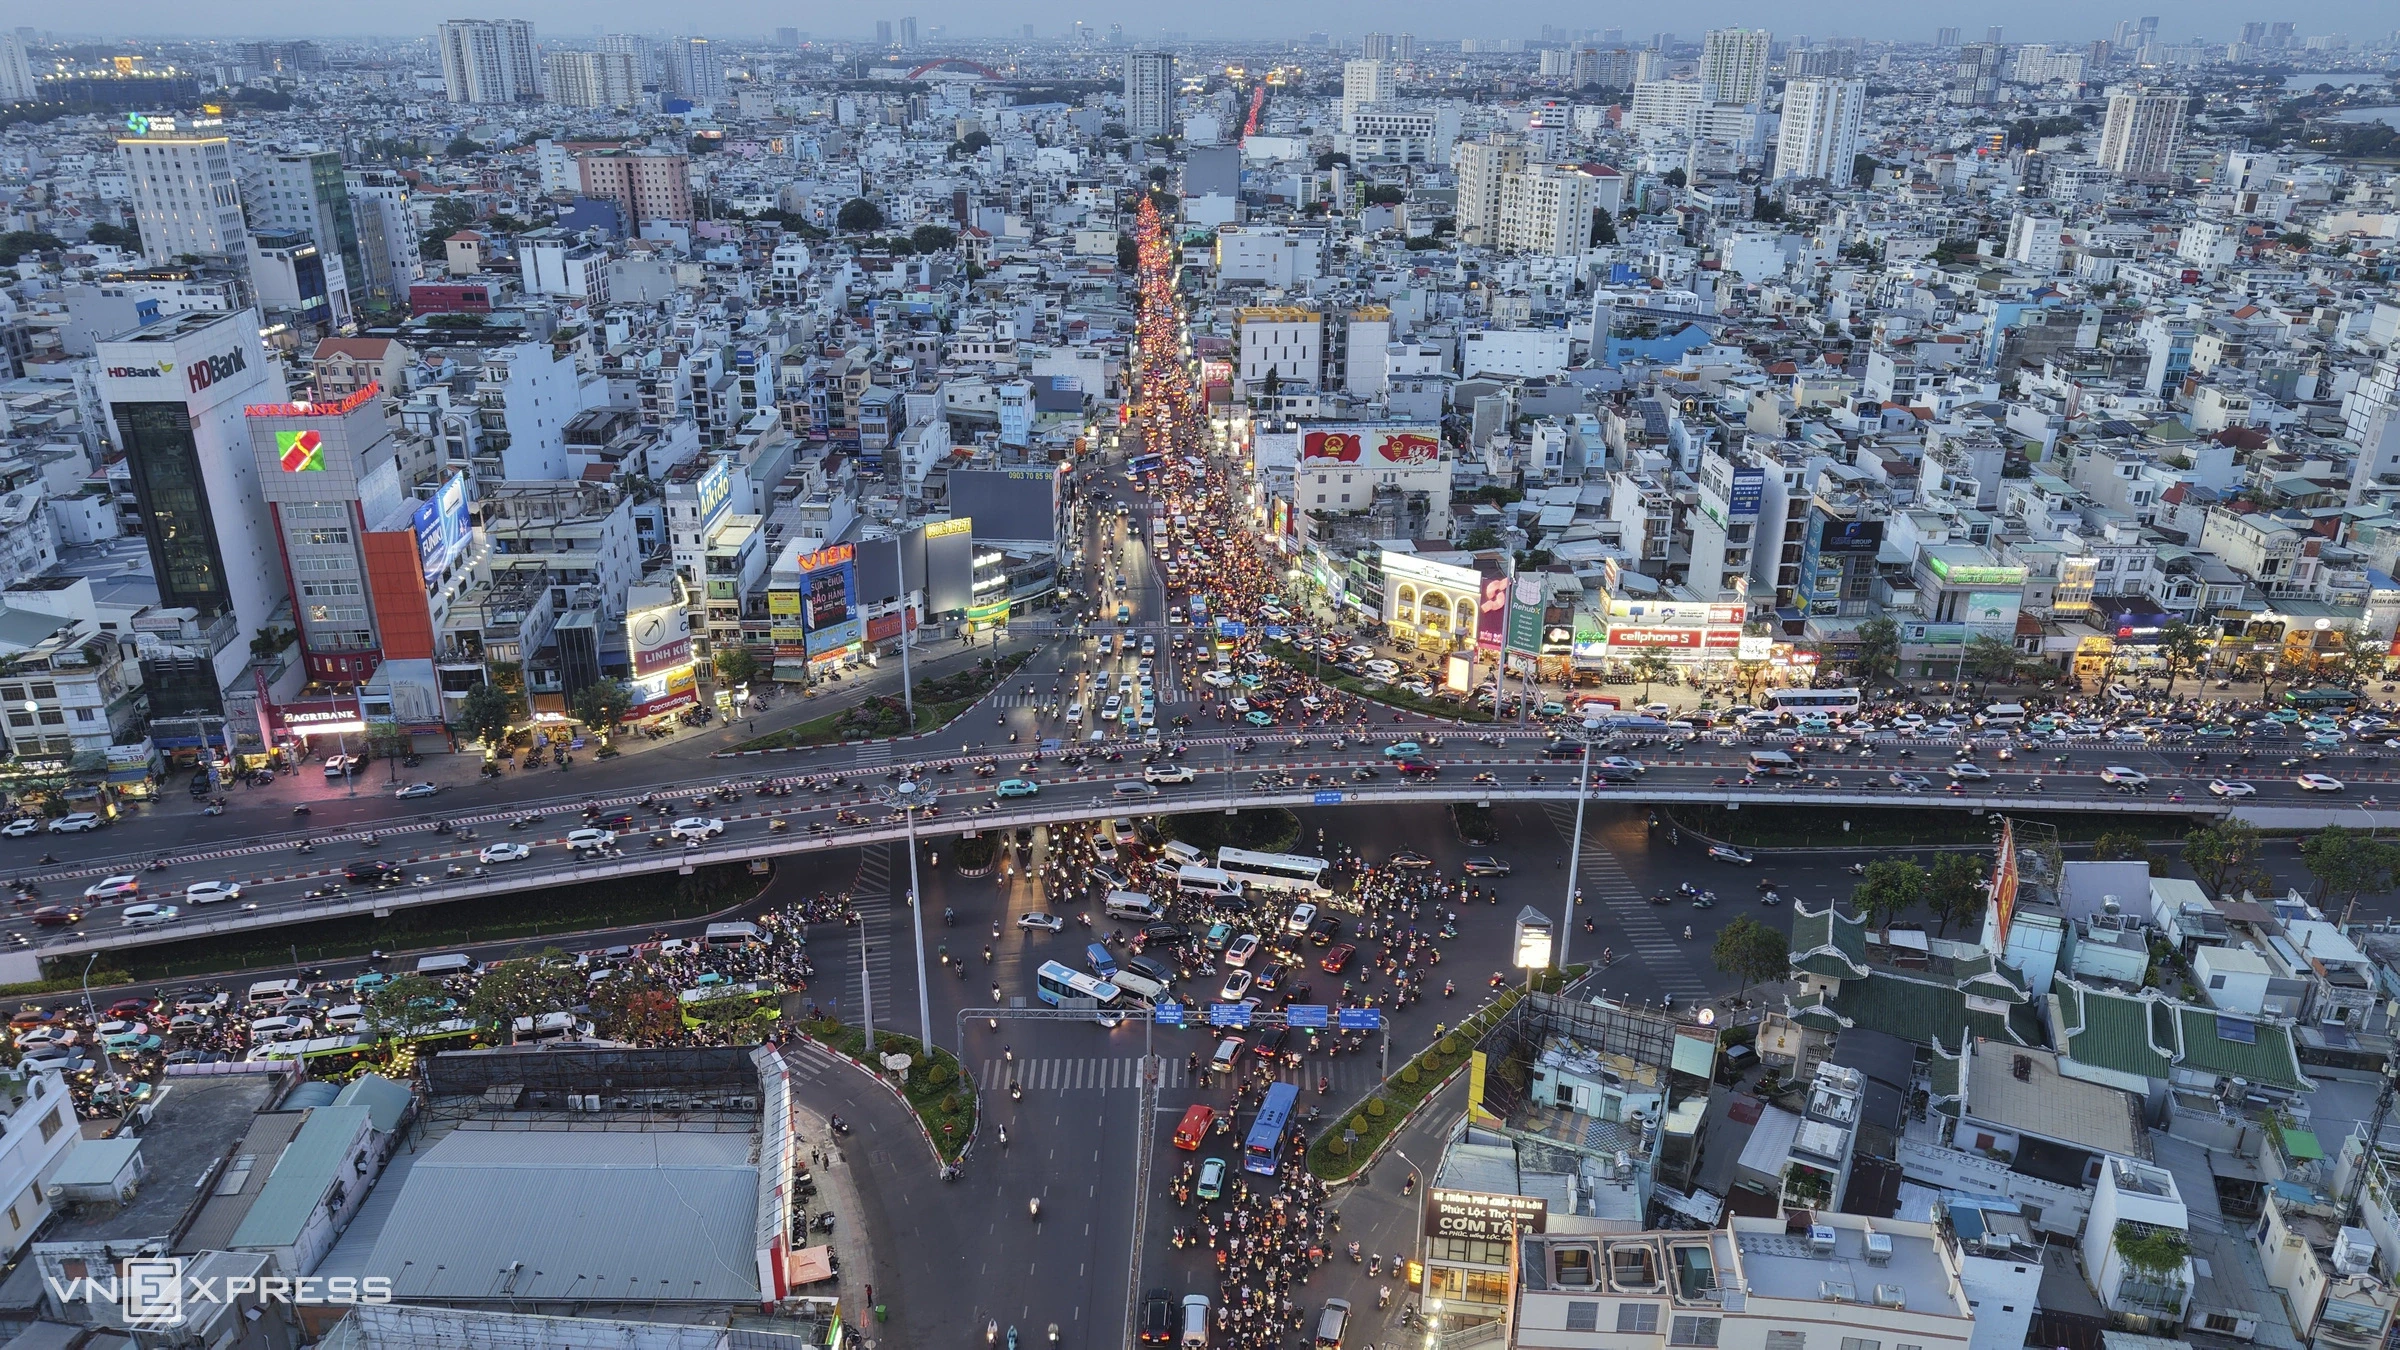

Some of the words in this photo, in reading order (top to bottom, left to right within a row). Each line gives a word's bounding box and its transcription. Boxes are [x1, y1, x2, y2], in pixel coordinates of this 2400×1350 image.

[107, 367, 160, 377] HDBank
[187, 345, 247, 393] HDBank
[341, 380, 379, 413] AGRIBANK
[244, 404, 342, 416] AGRIBANK
[1009, 472, 1024, 480] 0903
[701, 473, 729, 521] Aikido
[798, 543, 853, 571] VIỆN
[846, 605, 856, 615] 26
[1513, 602, 1541, 615] RehubX
[891, 615, 914, 632] HONG
[1620, 631, 1678, 643] cellphone
[1680, 634, 1690, 643] S
[645, 651, 671, 663] LINH
[294, 710, 356, 722] AGRIBANK
[1441, 1203, 1466, 1215] Phúc
[1467, 1206, 1487, 1218] Lộc
[1440, 1217, 1486, 1233] CƠM
